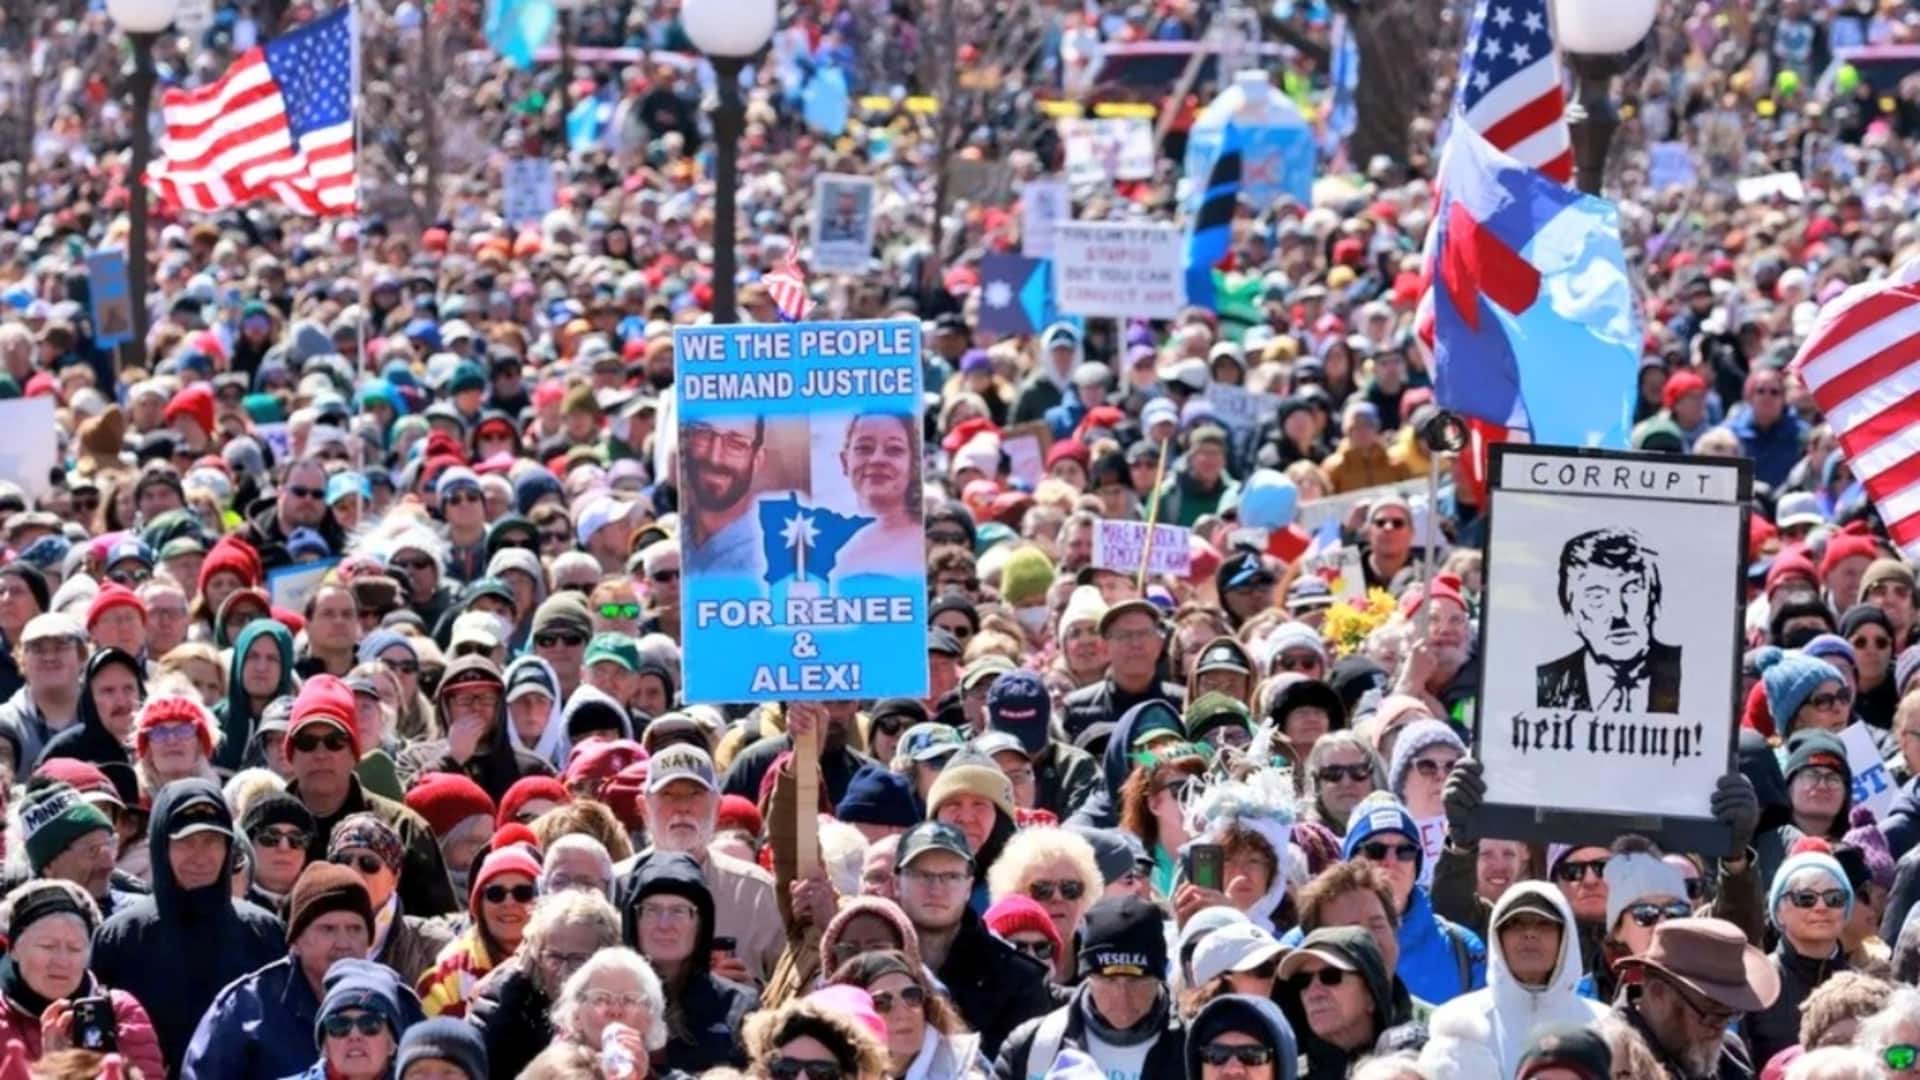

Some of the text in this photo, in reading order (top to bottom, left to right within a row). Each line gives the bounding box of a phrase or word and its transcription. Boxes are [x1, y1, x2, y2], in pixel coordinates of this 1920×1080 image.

[1099, 267, 1132, 282] YOU
[682, 328, 912, 361] WE THE PEOPLE
[684, 367, 913, 401] DEMAND JUSTICE
[1530, 461, 1711, 494] CORRUPT
[697, 597, 913, 627] FOR RENEE
[792, 631, 818, 658] &
[751, 664, 861, 692] ALEX!
[1511, 711, 1704, 766] heil trump!
[661, 753, 706, 769] NAVY
[1096, 952, 1149, 966] VESELKA
